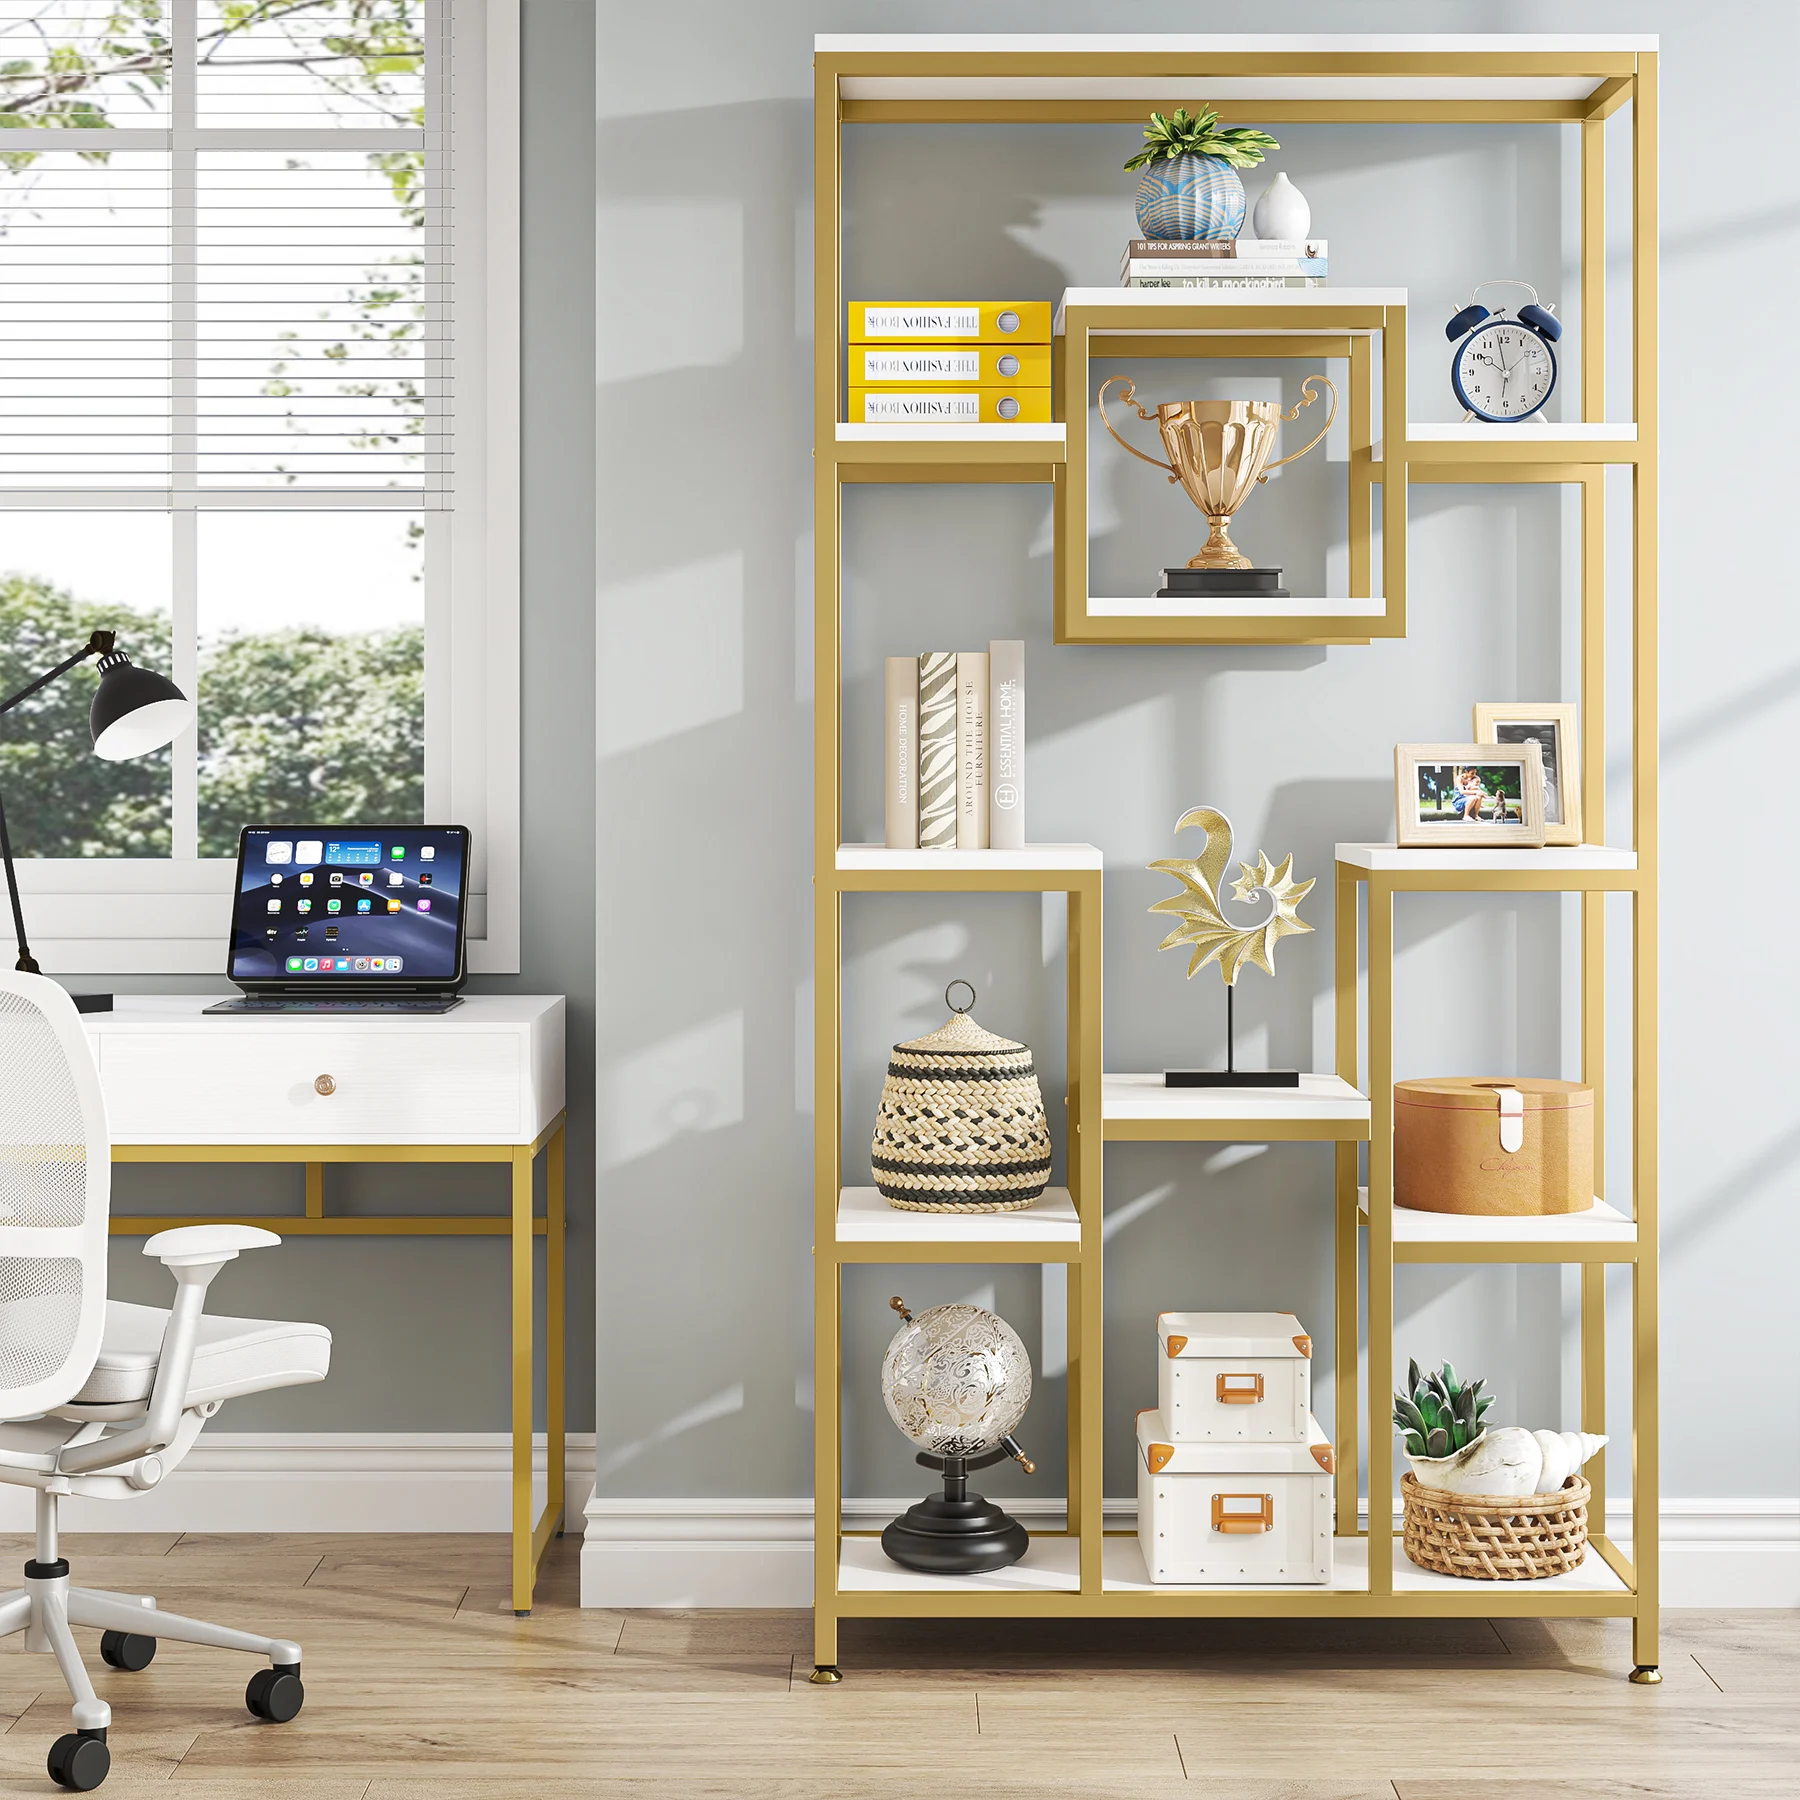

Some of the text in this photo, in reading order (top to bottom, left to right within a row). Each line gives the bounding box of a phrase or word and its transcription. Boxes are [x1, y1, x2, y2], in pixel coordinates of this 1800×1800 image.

[1137, 242, 1231, 251] 101 TIPS FOR ASPIRING GRANT WRITERS
[1161, 279, 1172, 288] lee
[1182, 277, 1286, 288] to kill a mockingbird
[868, 316, 978, 328] THE FASHION BOOK
[868, 360, 978, 372] THE FASHION BOOK
[868, 402, 978, 414] THE FASHION BOOK
[999, 680, 1012, 778] ESSENTIAL HOME
[898, 704, 908, 804] HOME DECORATION
[965, 681, 974, 817] AROUND THE HOUSE
[975, 712, 984, 786] FURNITURE
